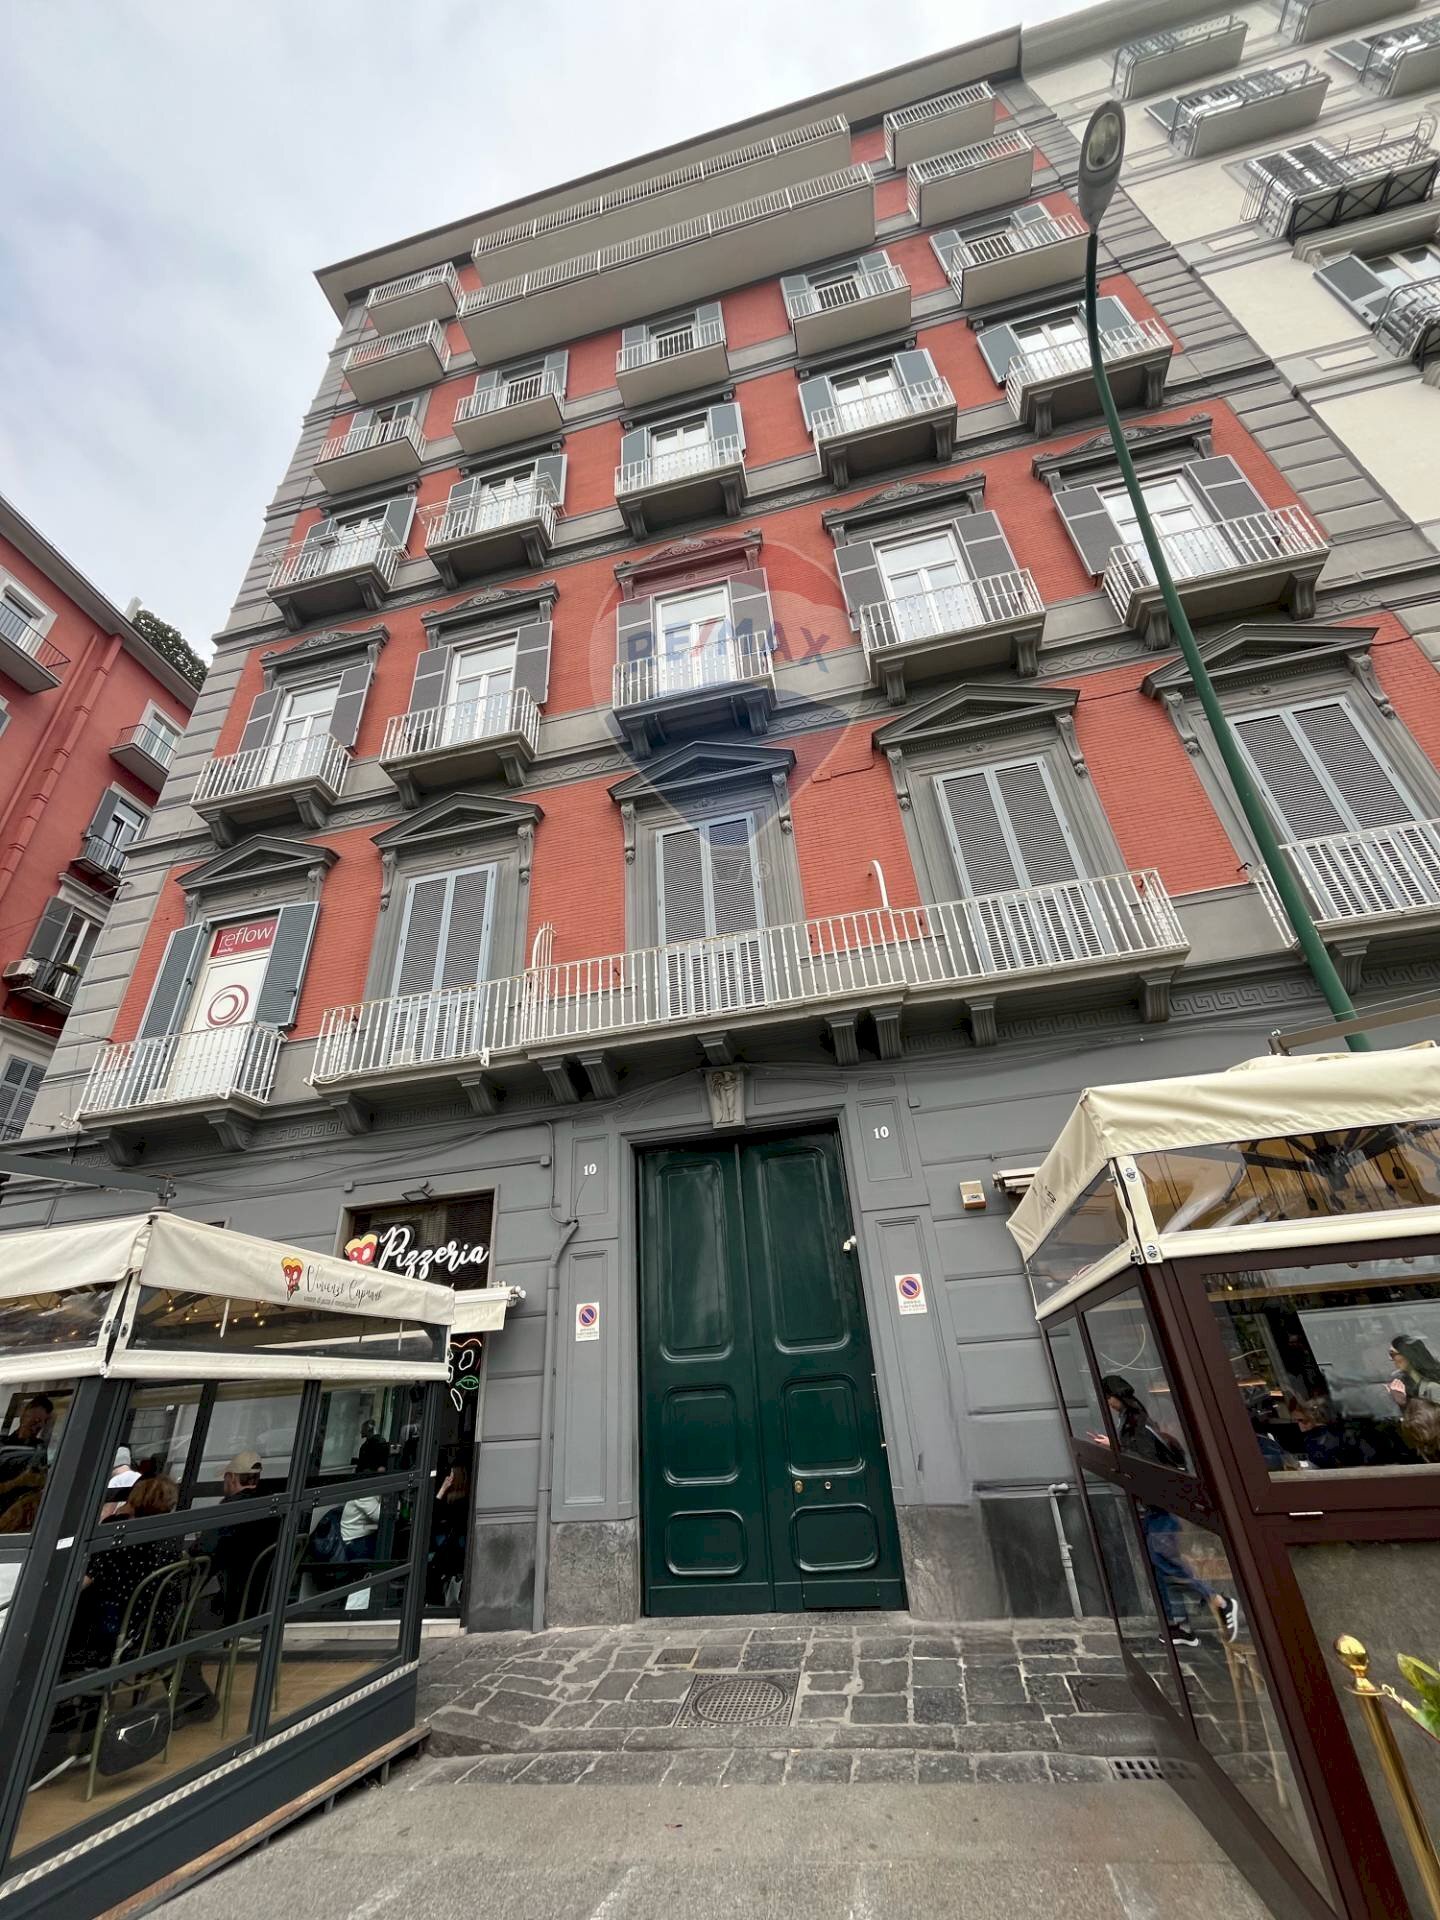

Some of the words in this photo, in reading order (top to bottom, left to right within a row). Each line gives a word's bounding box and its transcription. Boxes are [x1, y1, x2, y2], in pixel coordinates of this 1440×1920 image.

[218, 926, 273, 948] reflow
[873, 1126, 889, 1139] 10
[584, 1163, 597, 1175] 10
[378, 1226, 489, 1280] Pizzeria
